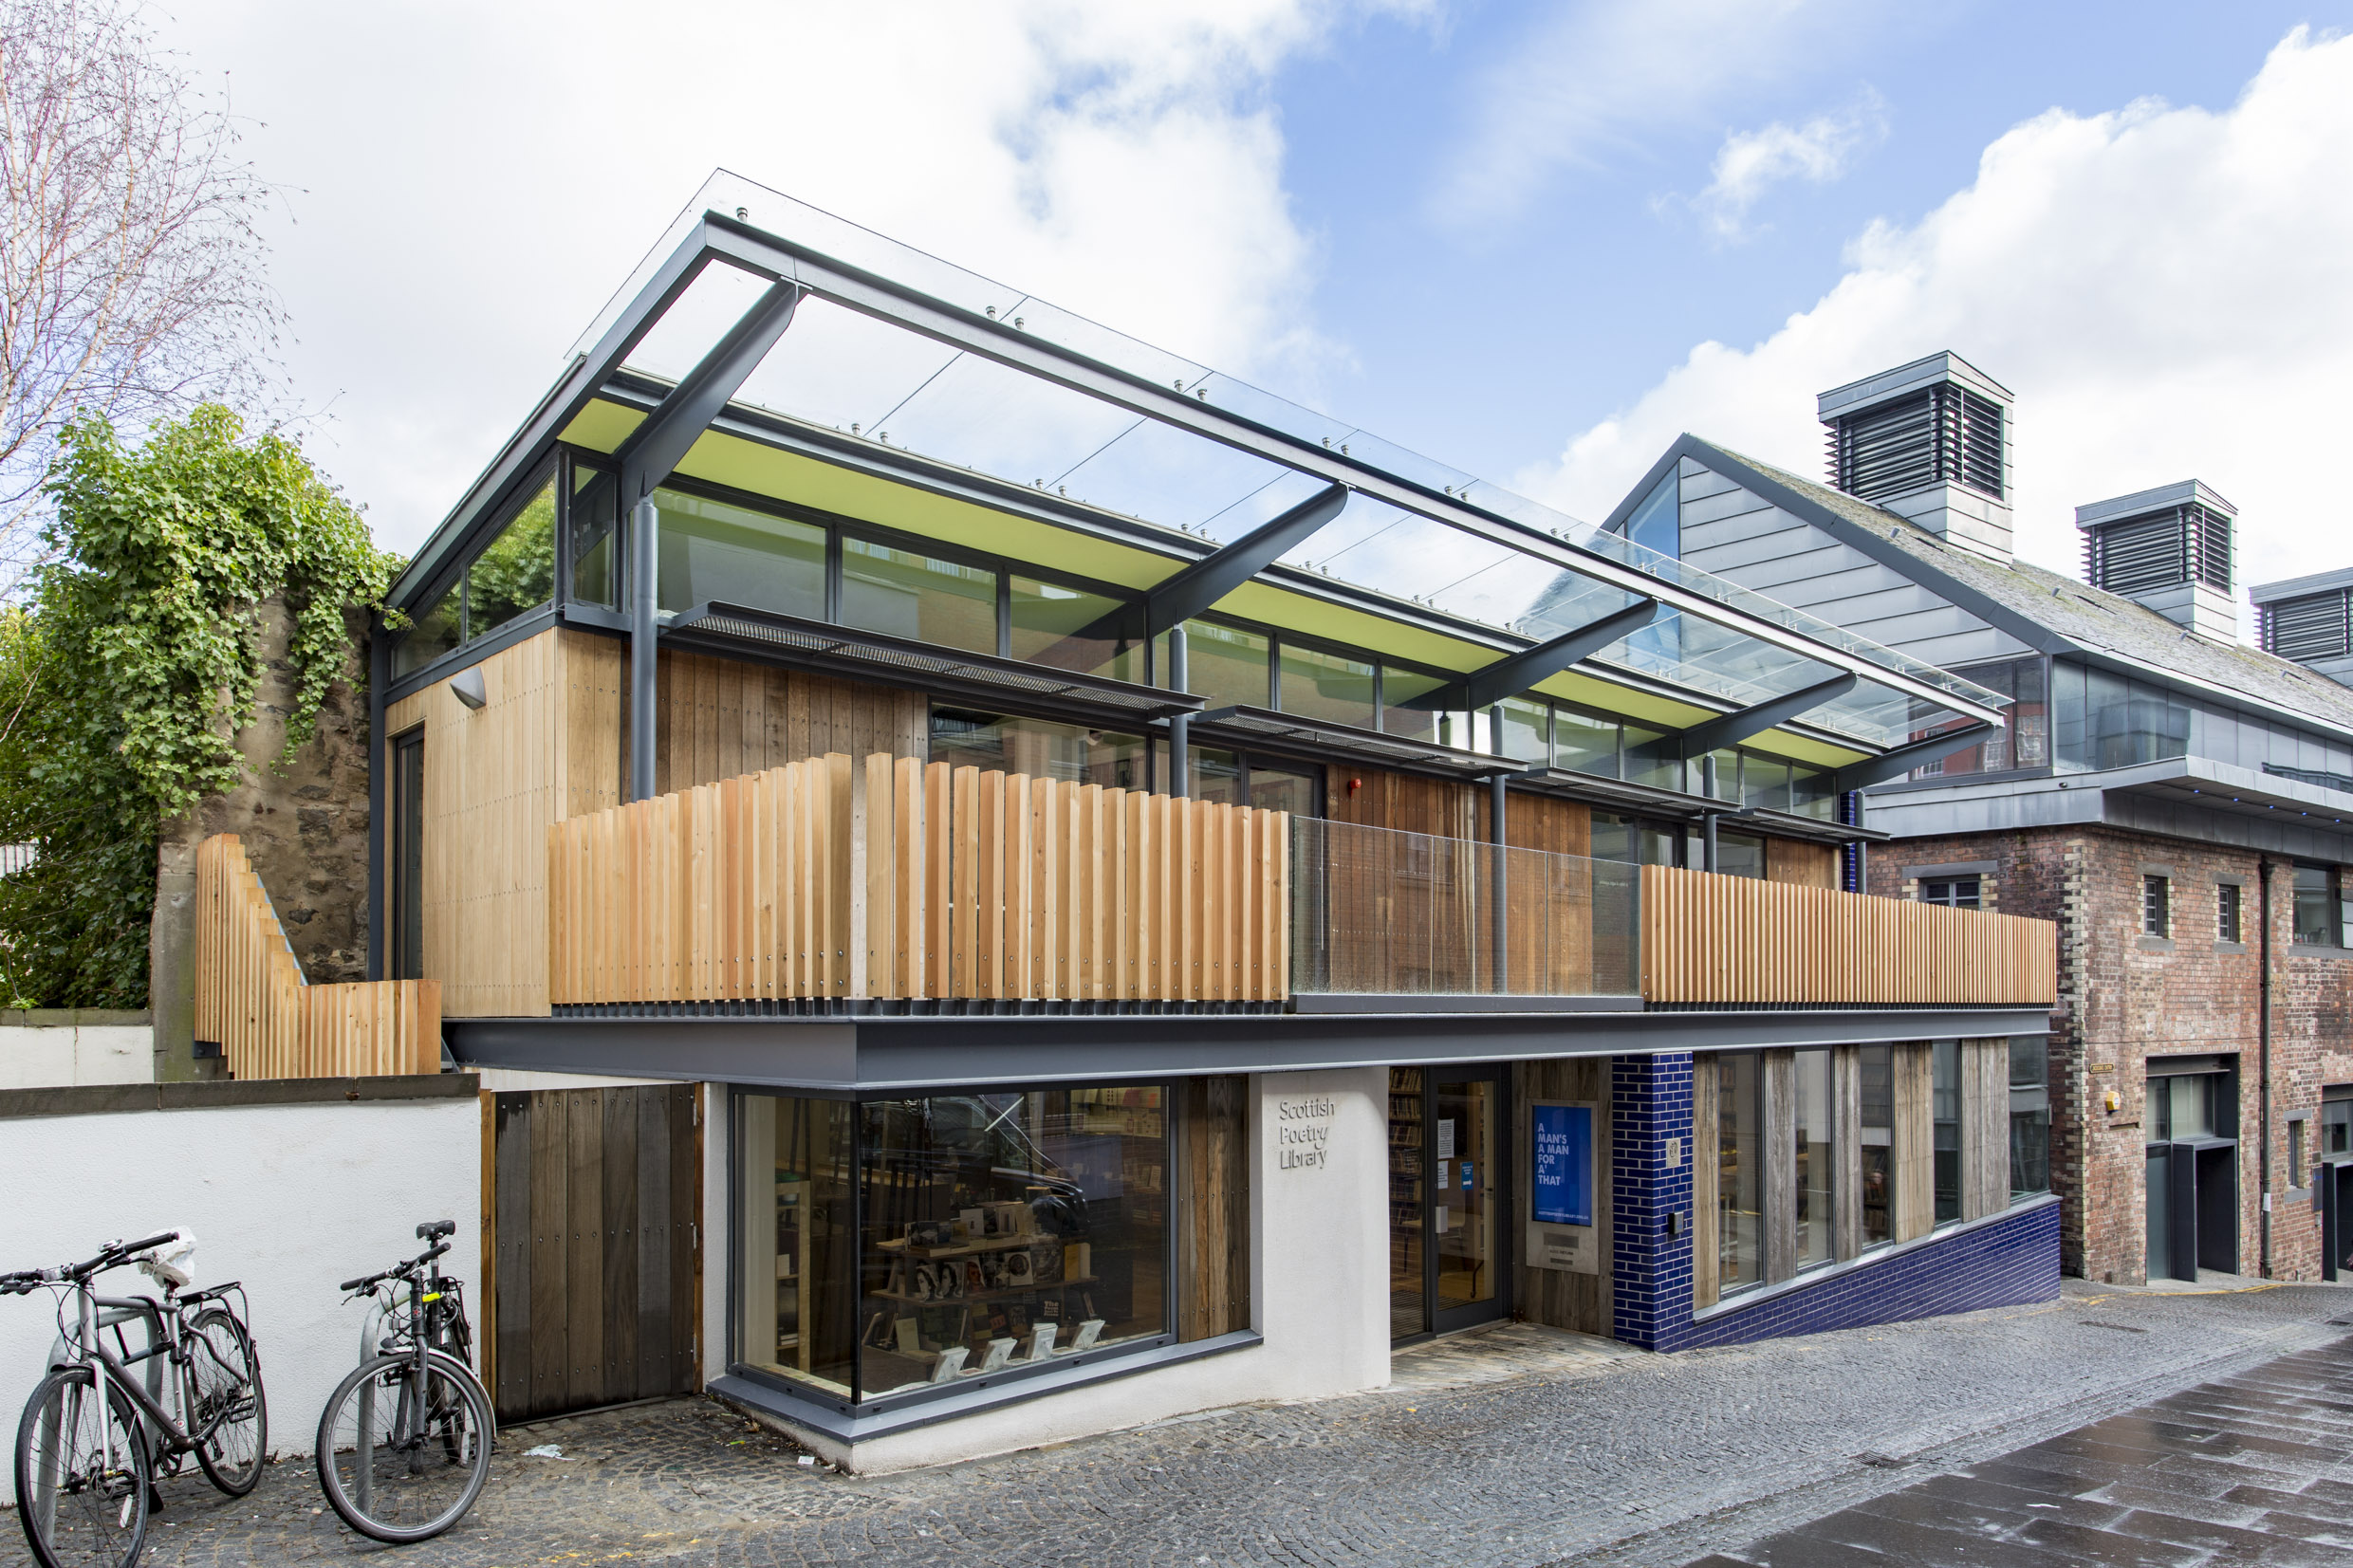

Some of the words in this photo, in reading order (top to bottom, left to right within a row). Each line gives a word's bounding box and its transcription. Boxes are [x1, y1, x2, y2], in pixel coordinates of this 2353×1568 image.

[1279, 1098, 1335, 1120] Scottish
[1538, 1123, 1545, 1133] A
[1280, 1125, 1328, 1150] Poetry
[1538, 1134, 1567, 1144] MAN'S
[1538, 1144, 1545, 1153] A
[1547, 1144, 1569, 1155] MAN
[1280, 1149, 1327, 1170] Library
[1538, 1153, 1555, 1165] FOR
[1538, 1164, 1547, 1174] A'
[1538, 1175, 1561, 1186] THAT
